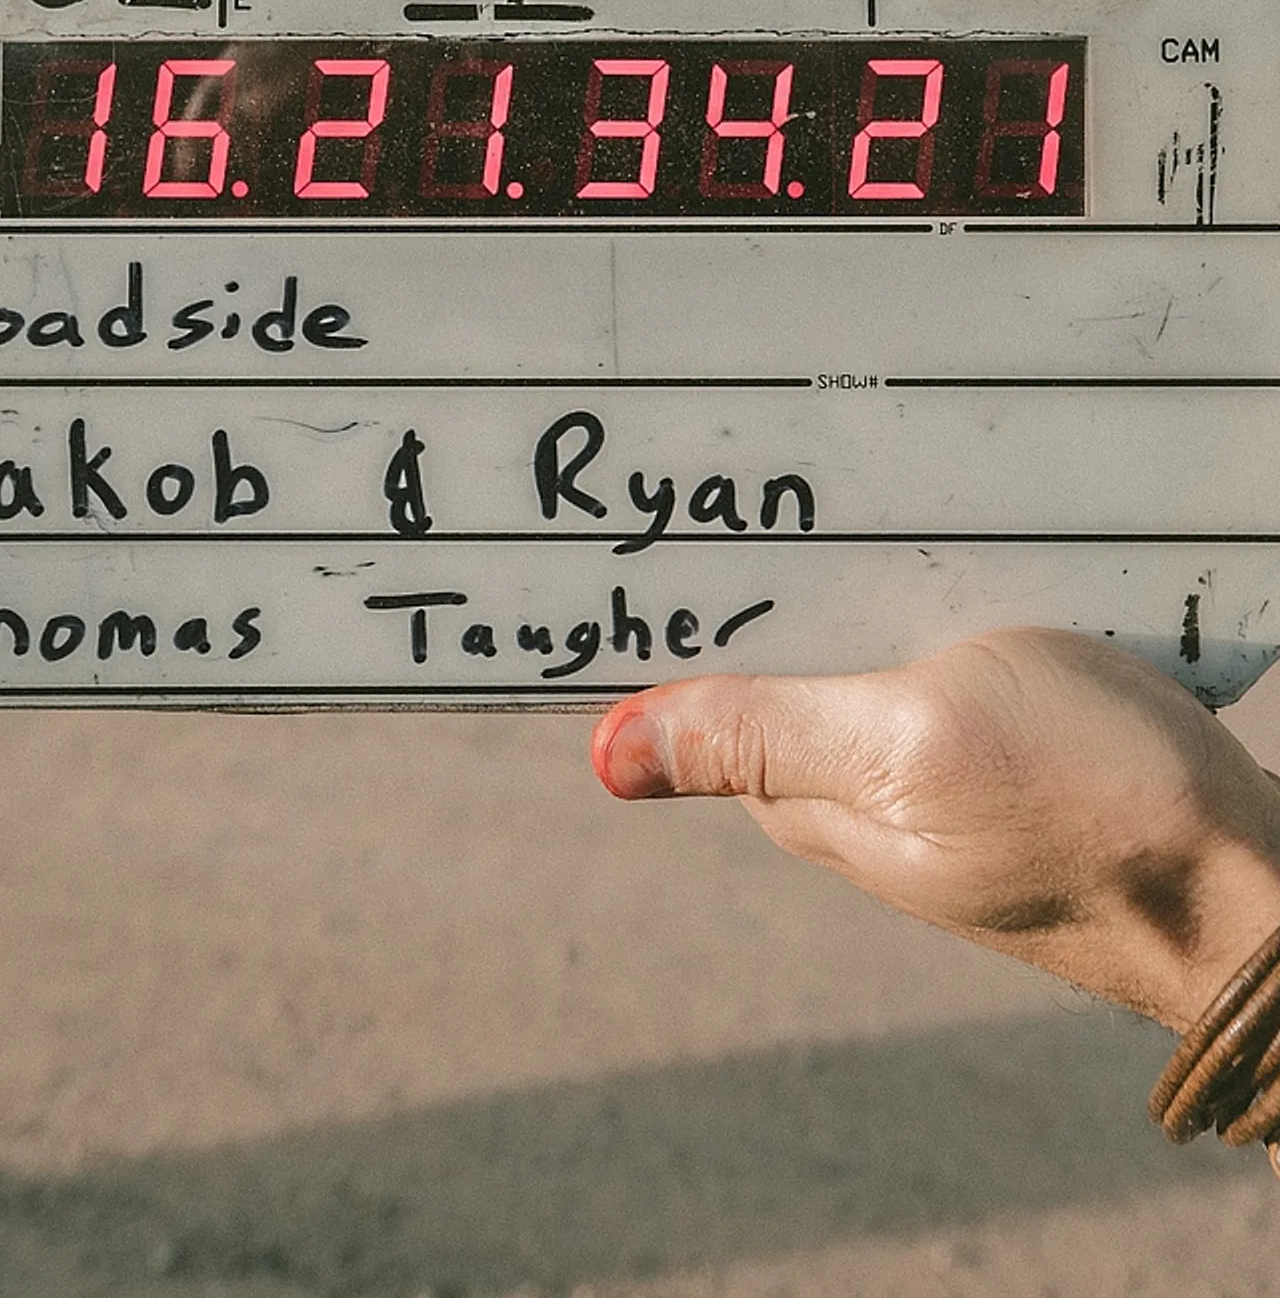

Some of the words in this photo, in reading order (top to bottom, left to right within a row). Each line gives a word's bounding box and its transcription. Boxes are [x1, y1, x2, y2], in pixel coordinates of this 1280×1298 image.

[1161, 38, 1220, 63] CAM
[818, 374, 878, 389] SHOW#
[534, 410, 816, 556] Ryan
[364, 586, 775, 680] Taugher
